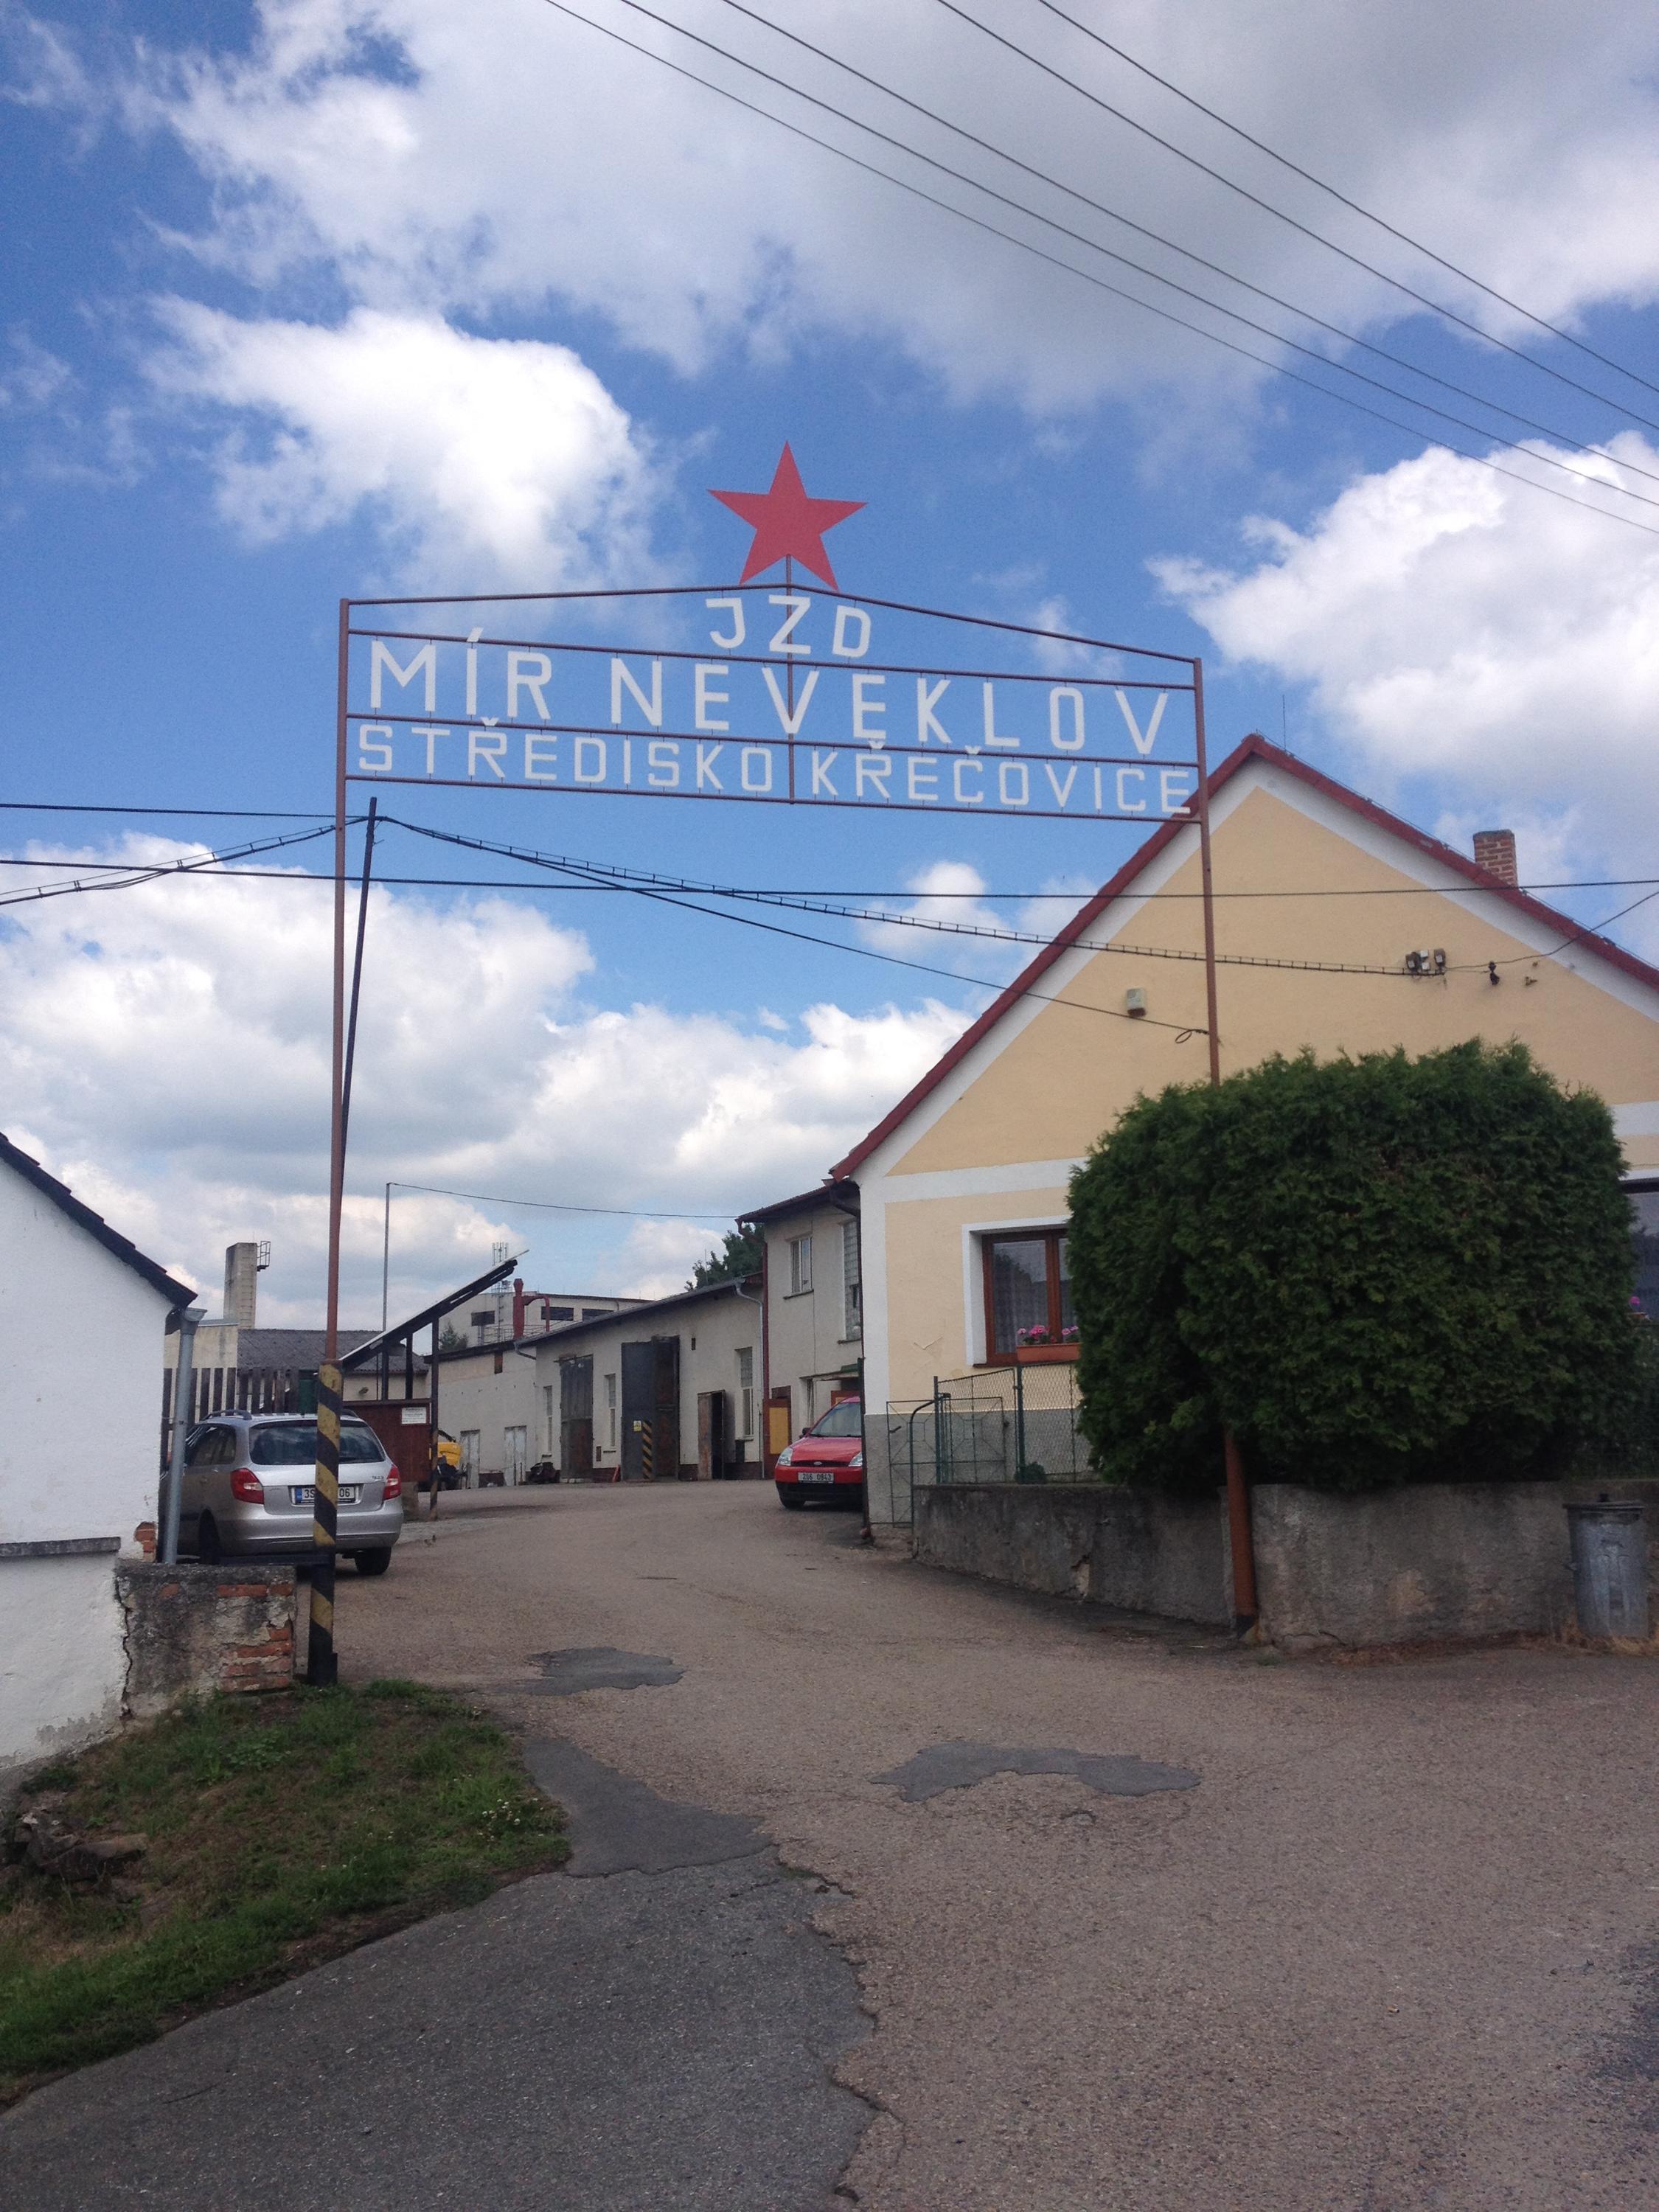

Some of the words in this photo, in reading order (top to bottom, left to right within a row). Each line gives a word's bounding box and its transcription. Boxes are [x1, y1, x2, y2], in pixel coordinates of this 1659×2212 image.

[706, 595, 872, 657] JZD
[370, 627, 552, 720] MÍR
[611, 657, 1169, 755] NEVEKLOV
[358, 717, 772, 793] STŘEDISKO
[812, 740, 1191, 814] KŘEČOVICE
